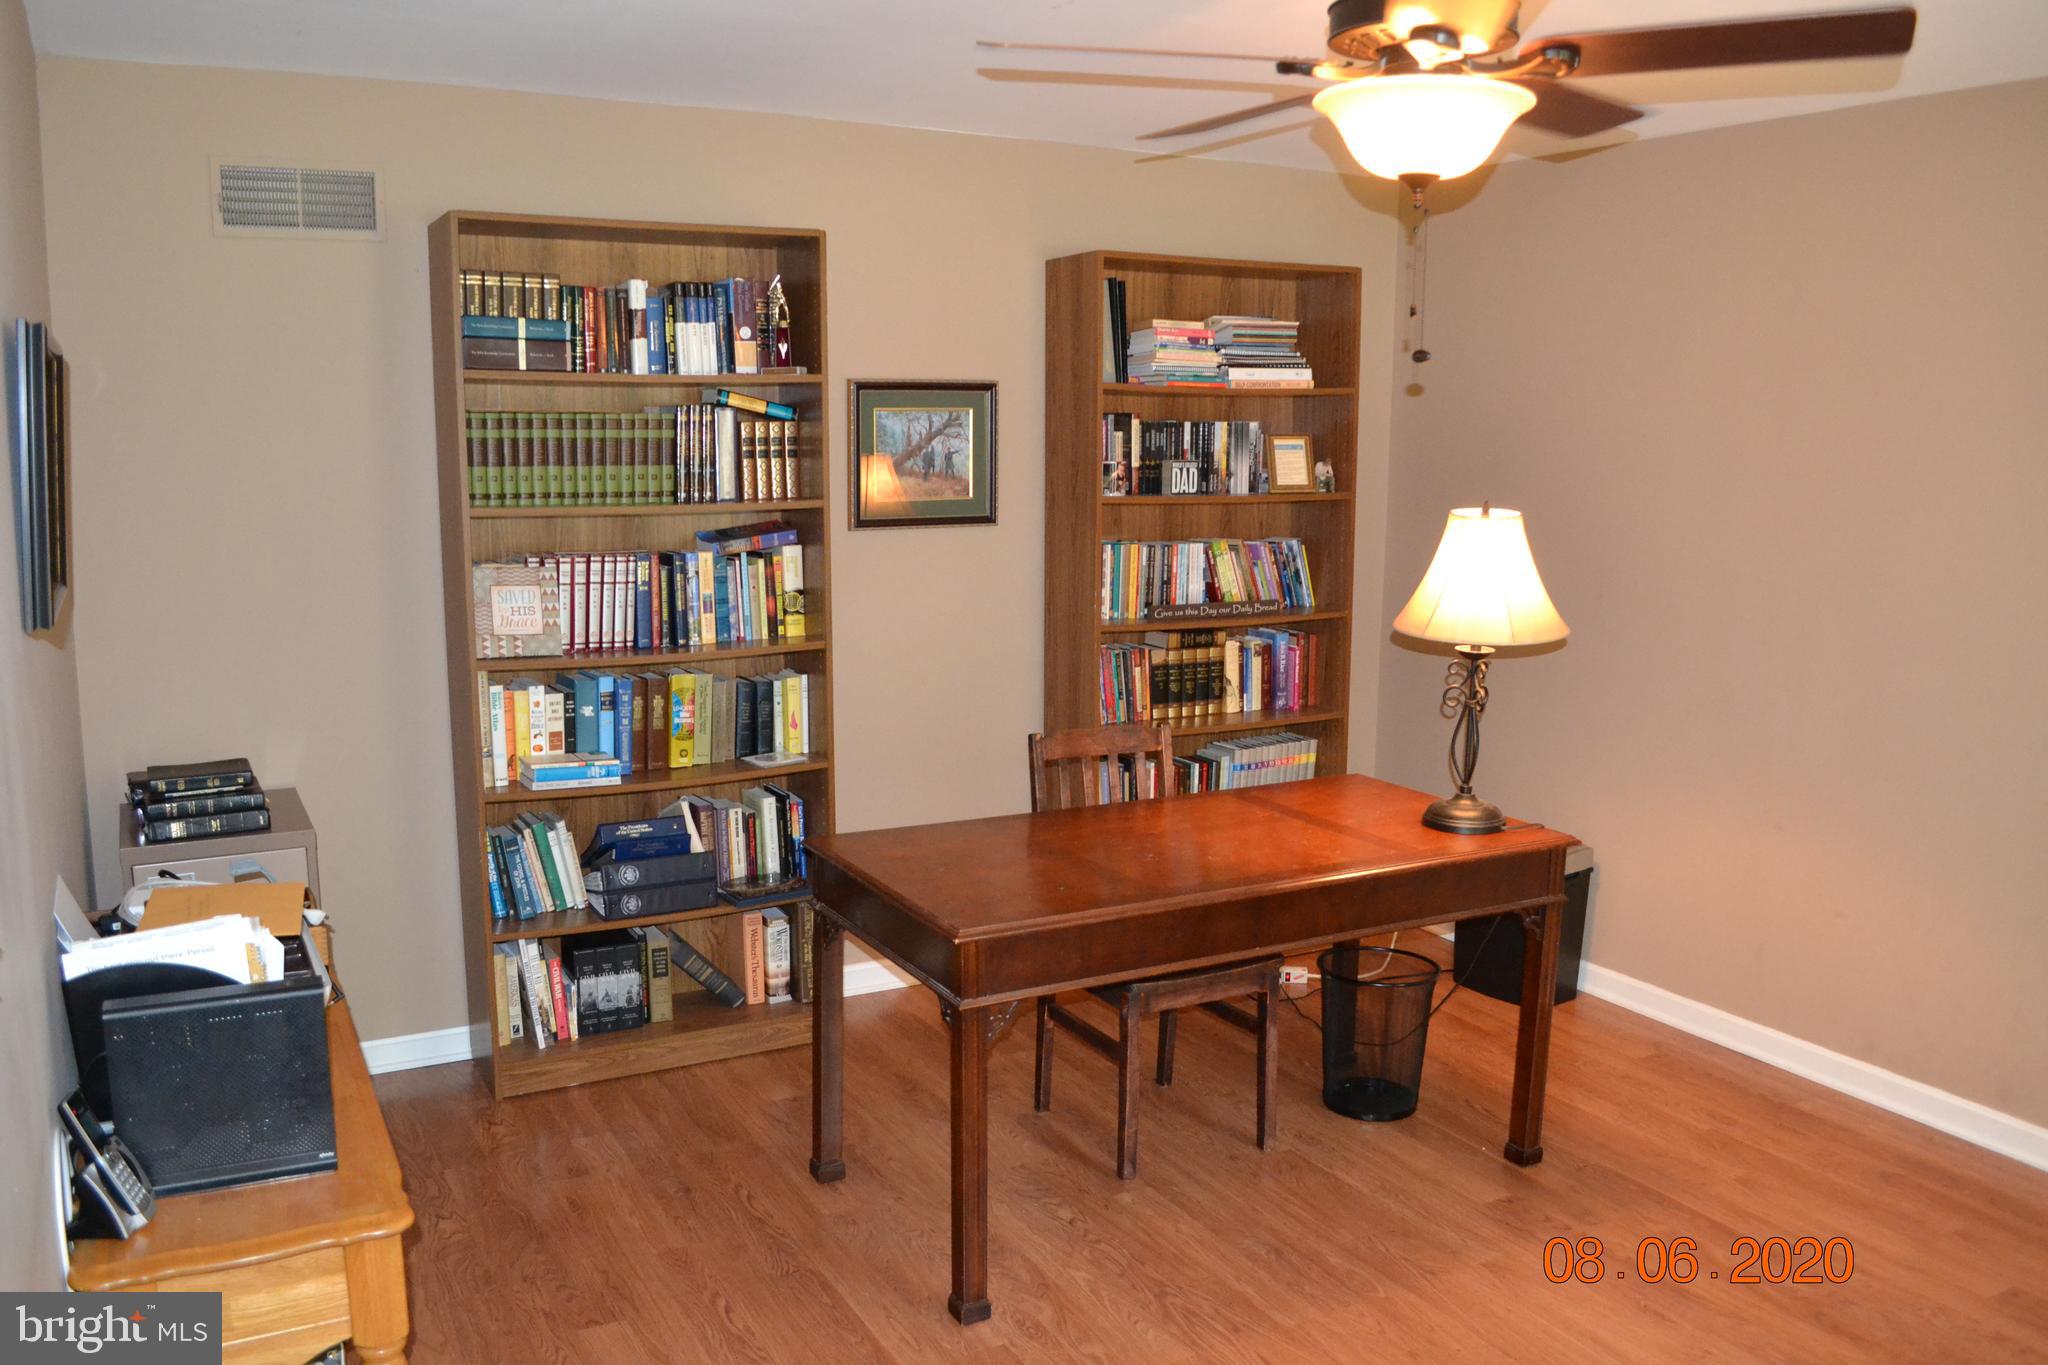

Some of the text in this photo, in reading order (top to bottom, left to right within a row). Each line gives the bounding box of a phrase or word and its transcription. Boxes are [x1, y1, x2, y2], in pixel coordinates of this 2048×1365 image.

[1171, 467, 1198, 494] DAD
[497, 589, 536, 605] SAVED
[509, 605, 536, 616] HIS
[1154, 608, 1173, 618] Give
[1185, 607, 1198, 616] this
[1200, 606, 1218, 617] Day
[1232, 604, 1252, 615] Daily
[1254, 602, 1278, 612] Bread
[750, 927, 760, 999] Webster's Thesaurus
